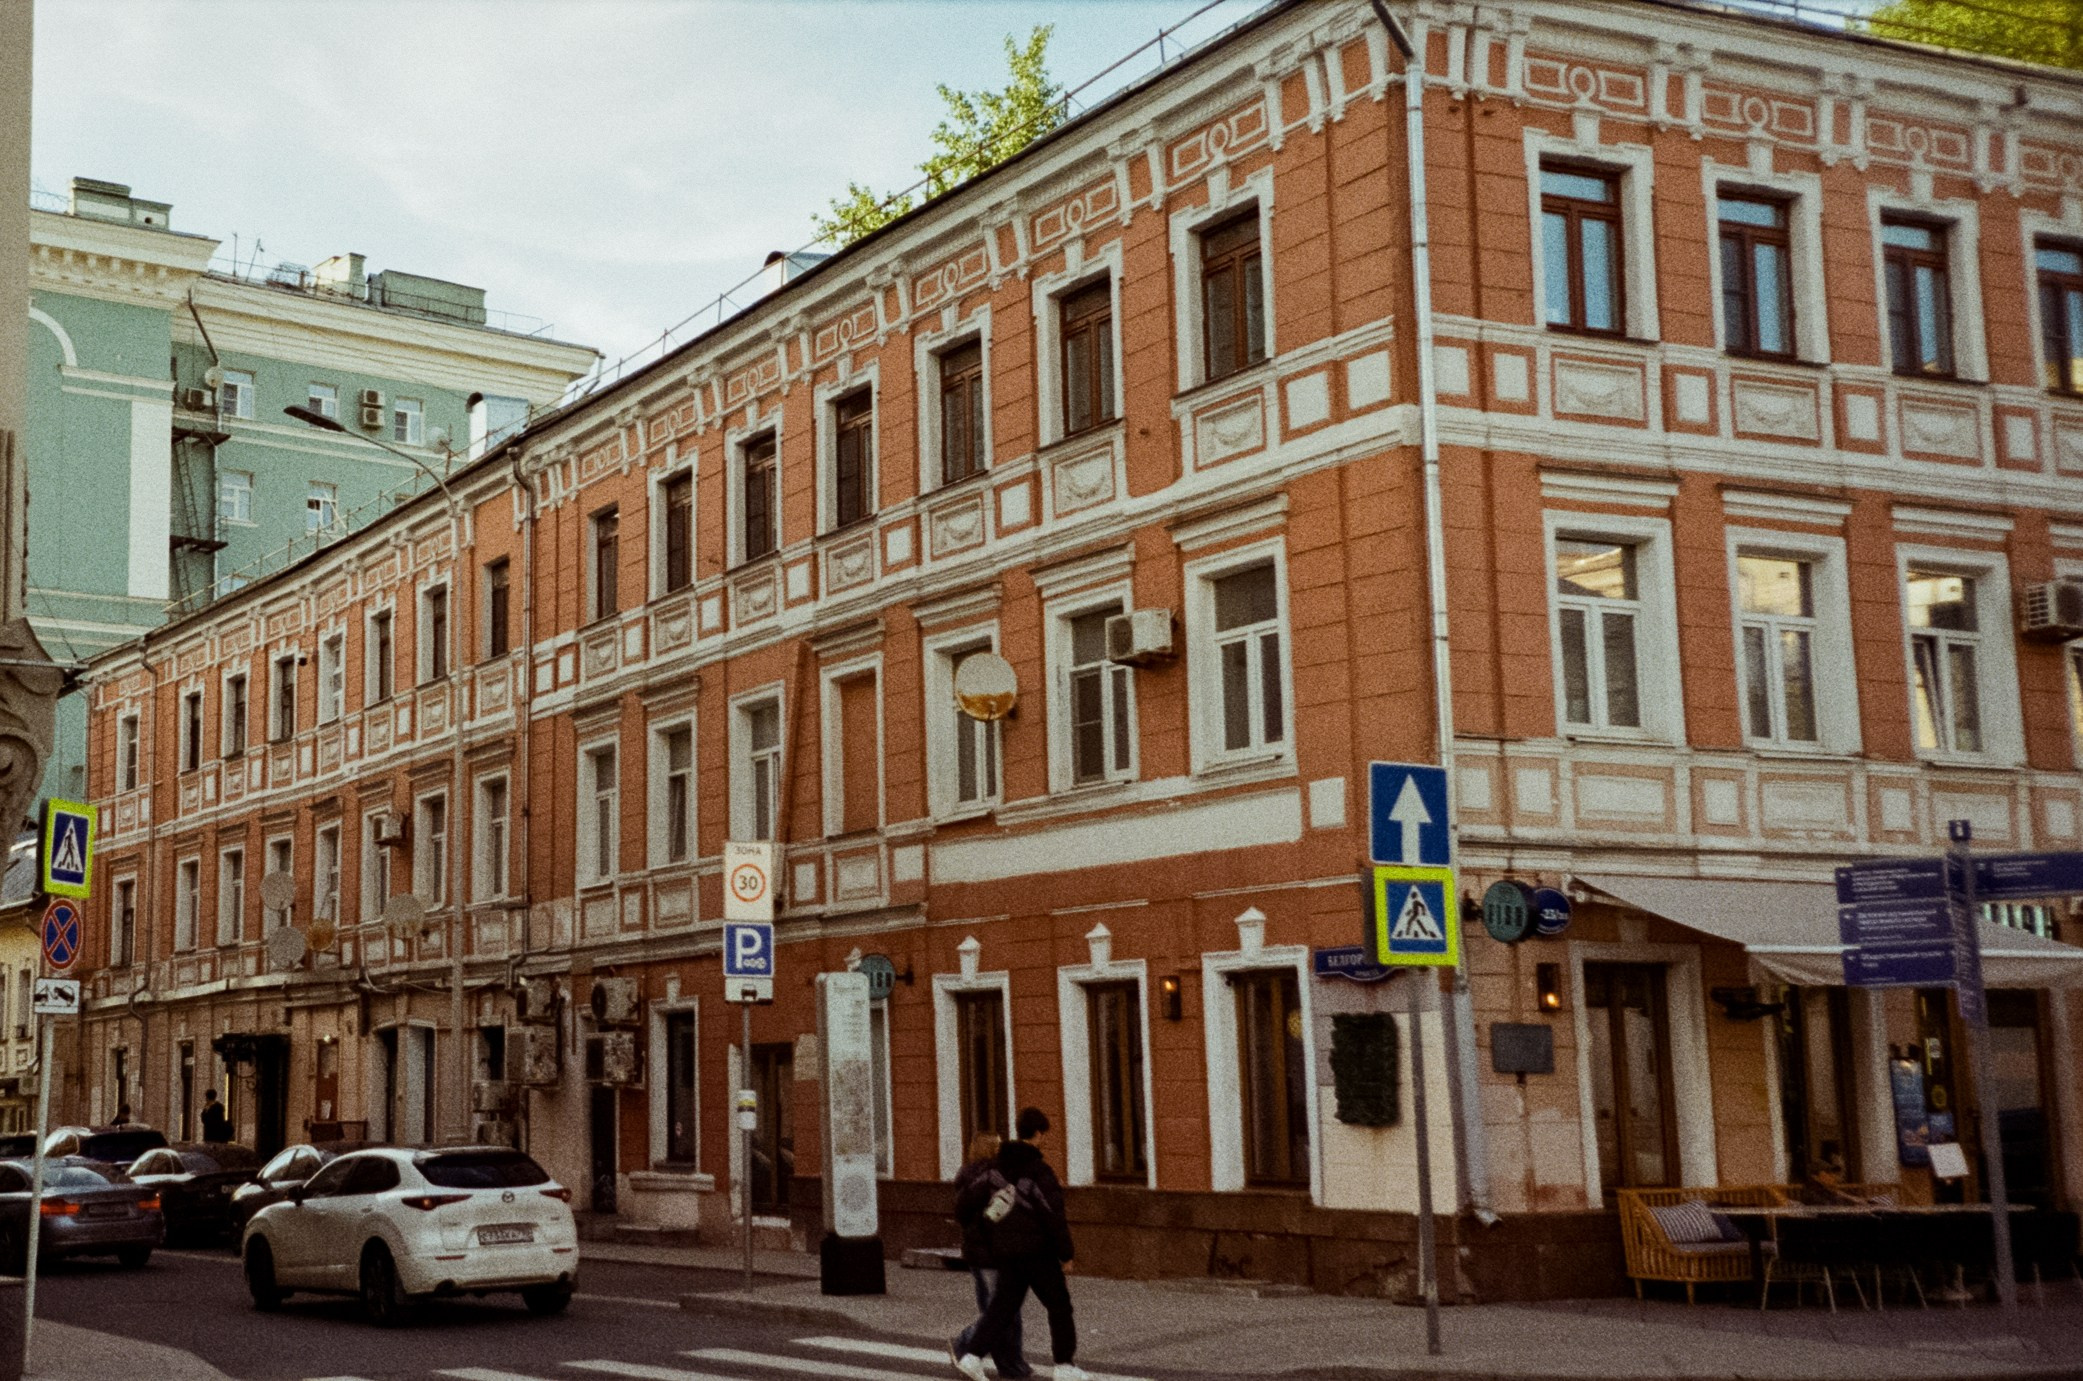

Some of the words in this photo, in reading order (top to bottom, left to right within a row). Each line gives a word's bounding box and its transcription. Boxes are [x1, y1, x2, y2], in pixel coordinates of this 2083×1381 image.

[735, 846, 761, 855] ЗОНА
[739, 875, 757, 890] 30
[736, 927, 761, 968] P
